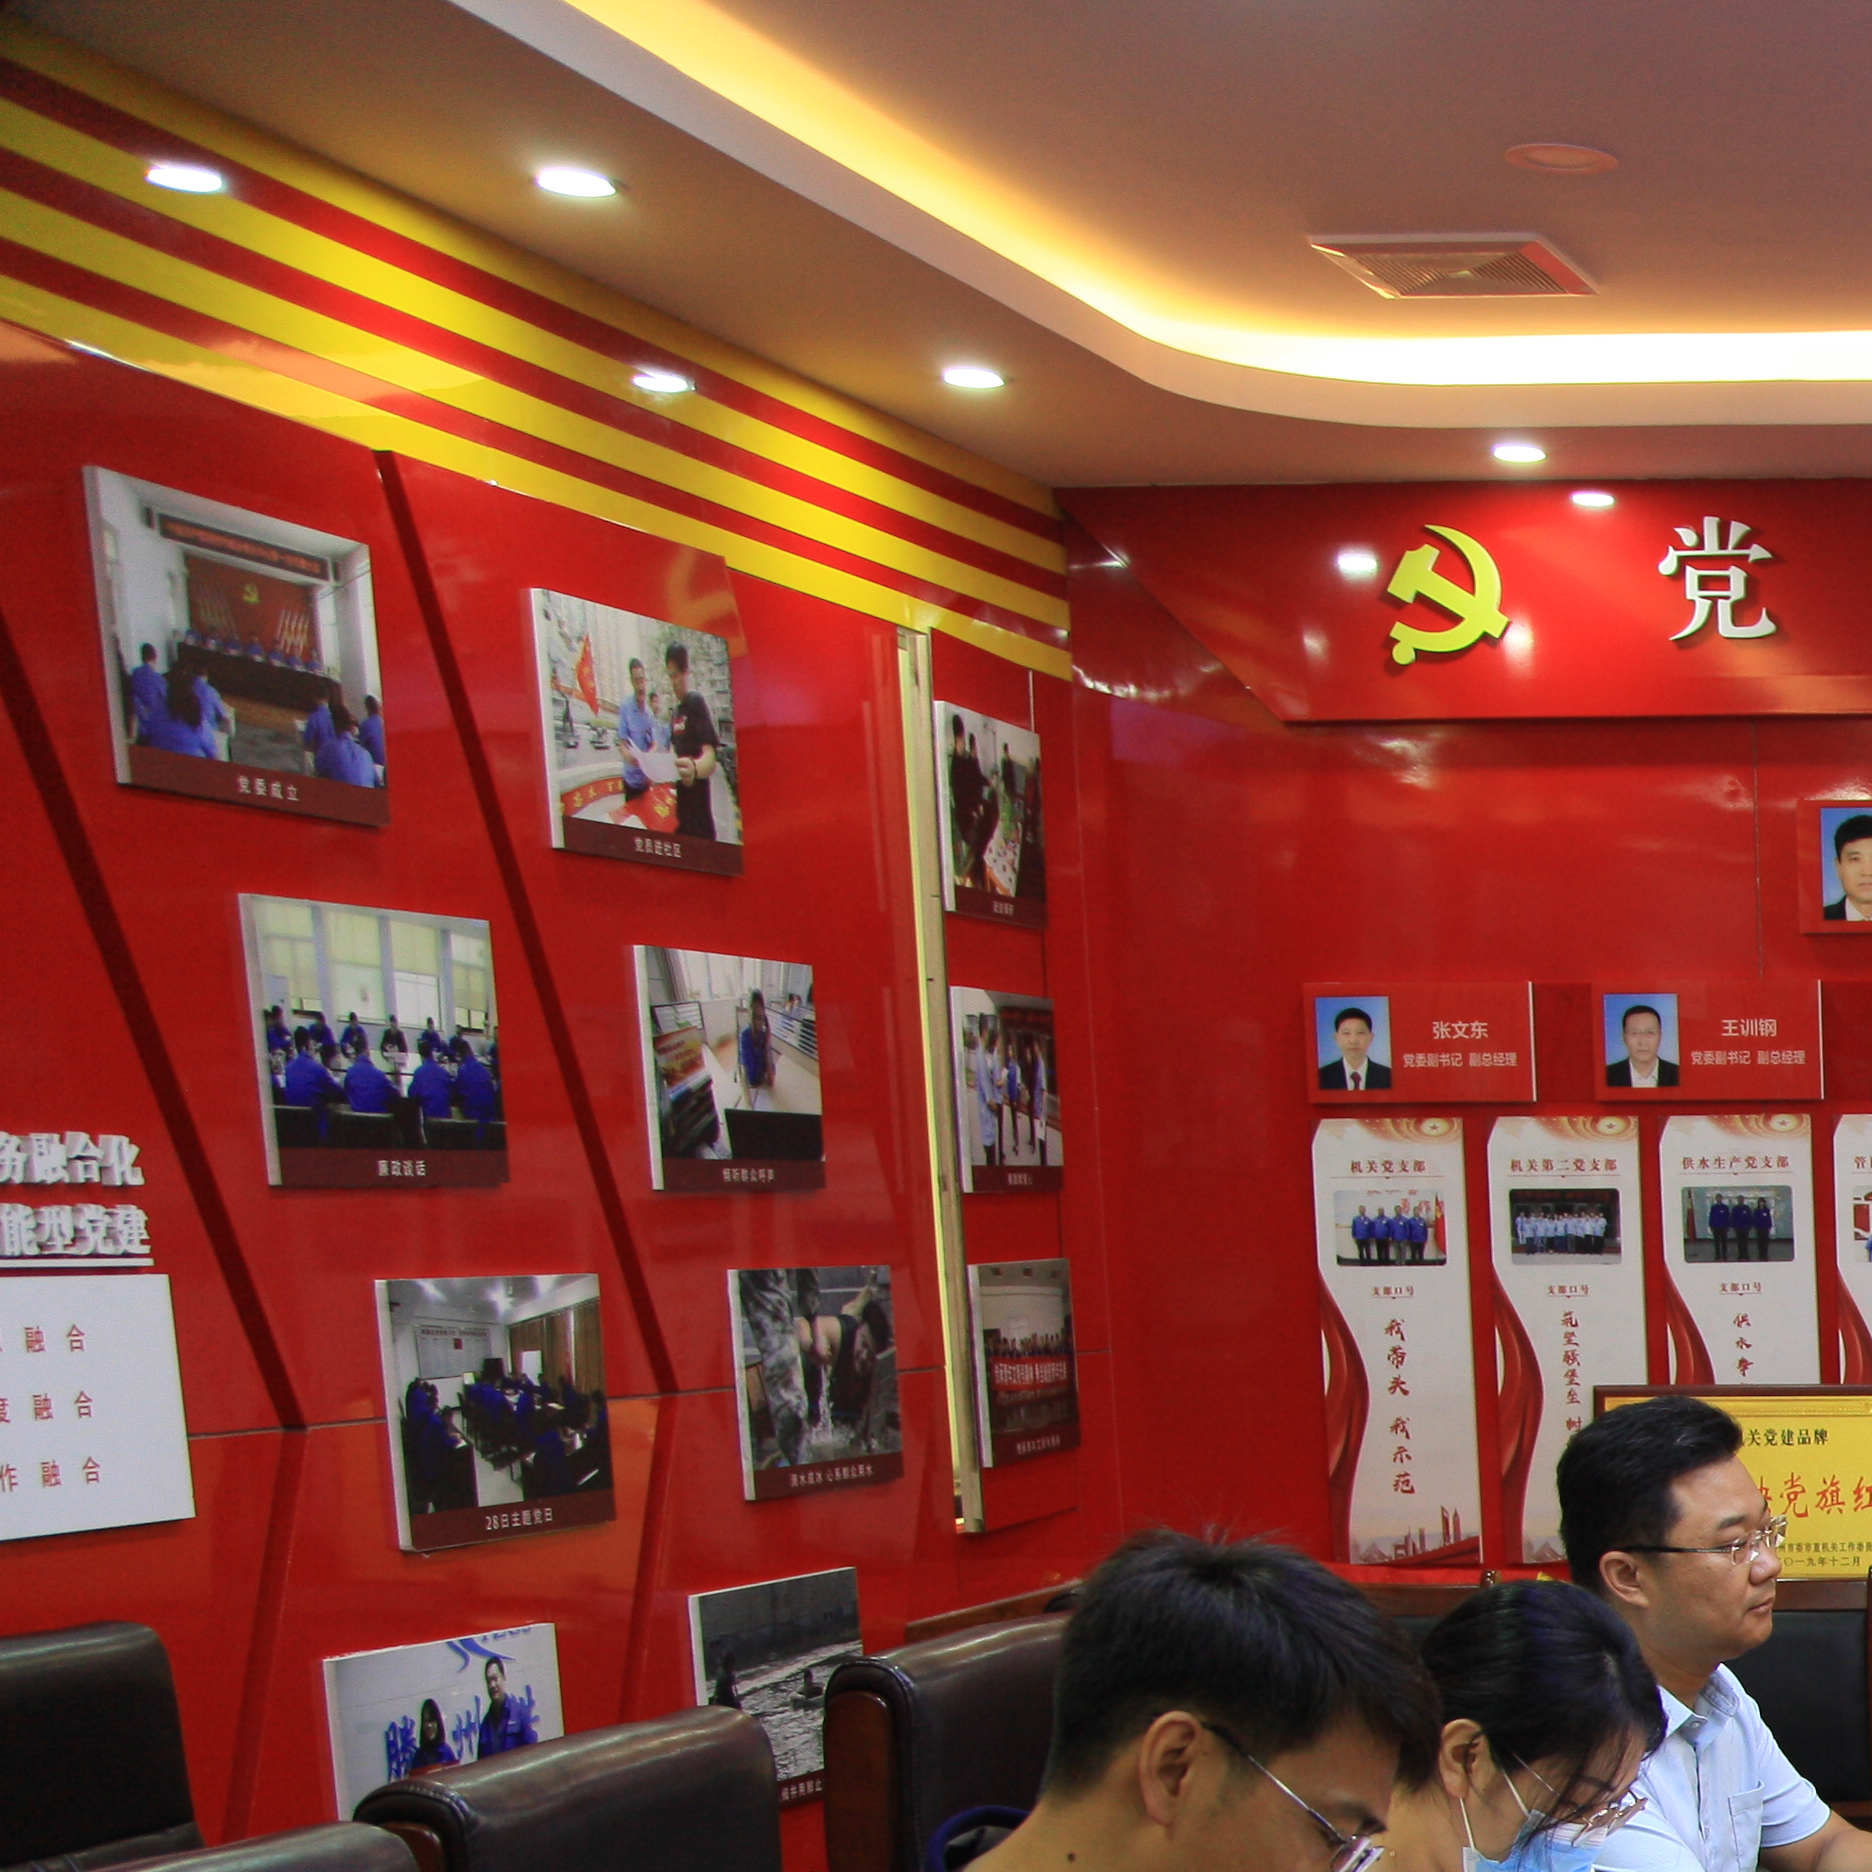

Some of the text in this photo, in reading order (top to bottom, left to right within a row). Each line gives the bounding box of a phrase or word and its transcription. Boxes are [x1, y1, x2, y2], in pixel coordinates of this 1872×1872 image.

[1431, 1019, 1488, 1040] 张文东
[1720, 1017, 1777, 1039] 王训钢
[1403, 1051, 1517, 1068] 党委副书记 副总经理
[1691, 1049, 1805, 1066] 党委副书记 副总经理
[1350, 1158, 1427, 1174] 机关党支部
[1510, 1157, 1619, 1173] 机关第二党支部
[1681, 1155, 1791, 1171] 供水生产党支部
[1371, 1285, 1415, 1298] 支部口号
[1547, 1284, 1589, 1297] 支部口号
[1719, 1281, 1763, 1294] 支部口号
[1384, 1319, 1415, 1495] 我带头 我示范
[1743, 1429, 1829, 1446] 关党建品牌
[485, 1507, 554, 1530] 28日主题党日
